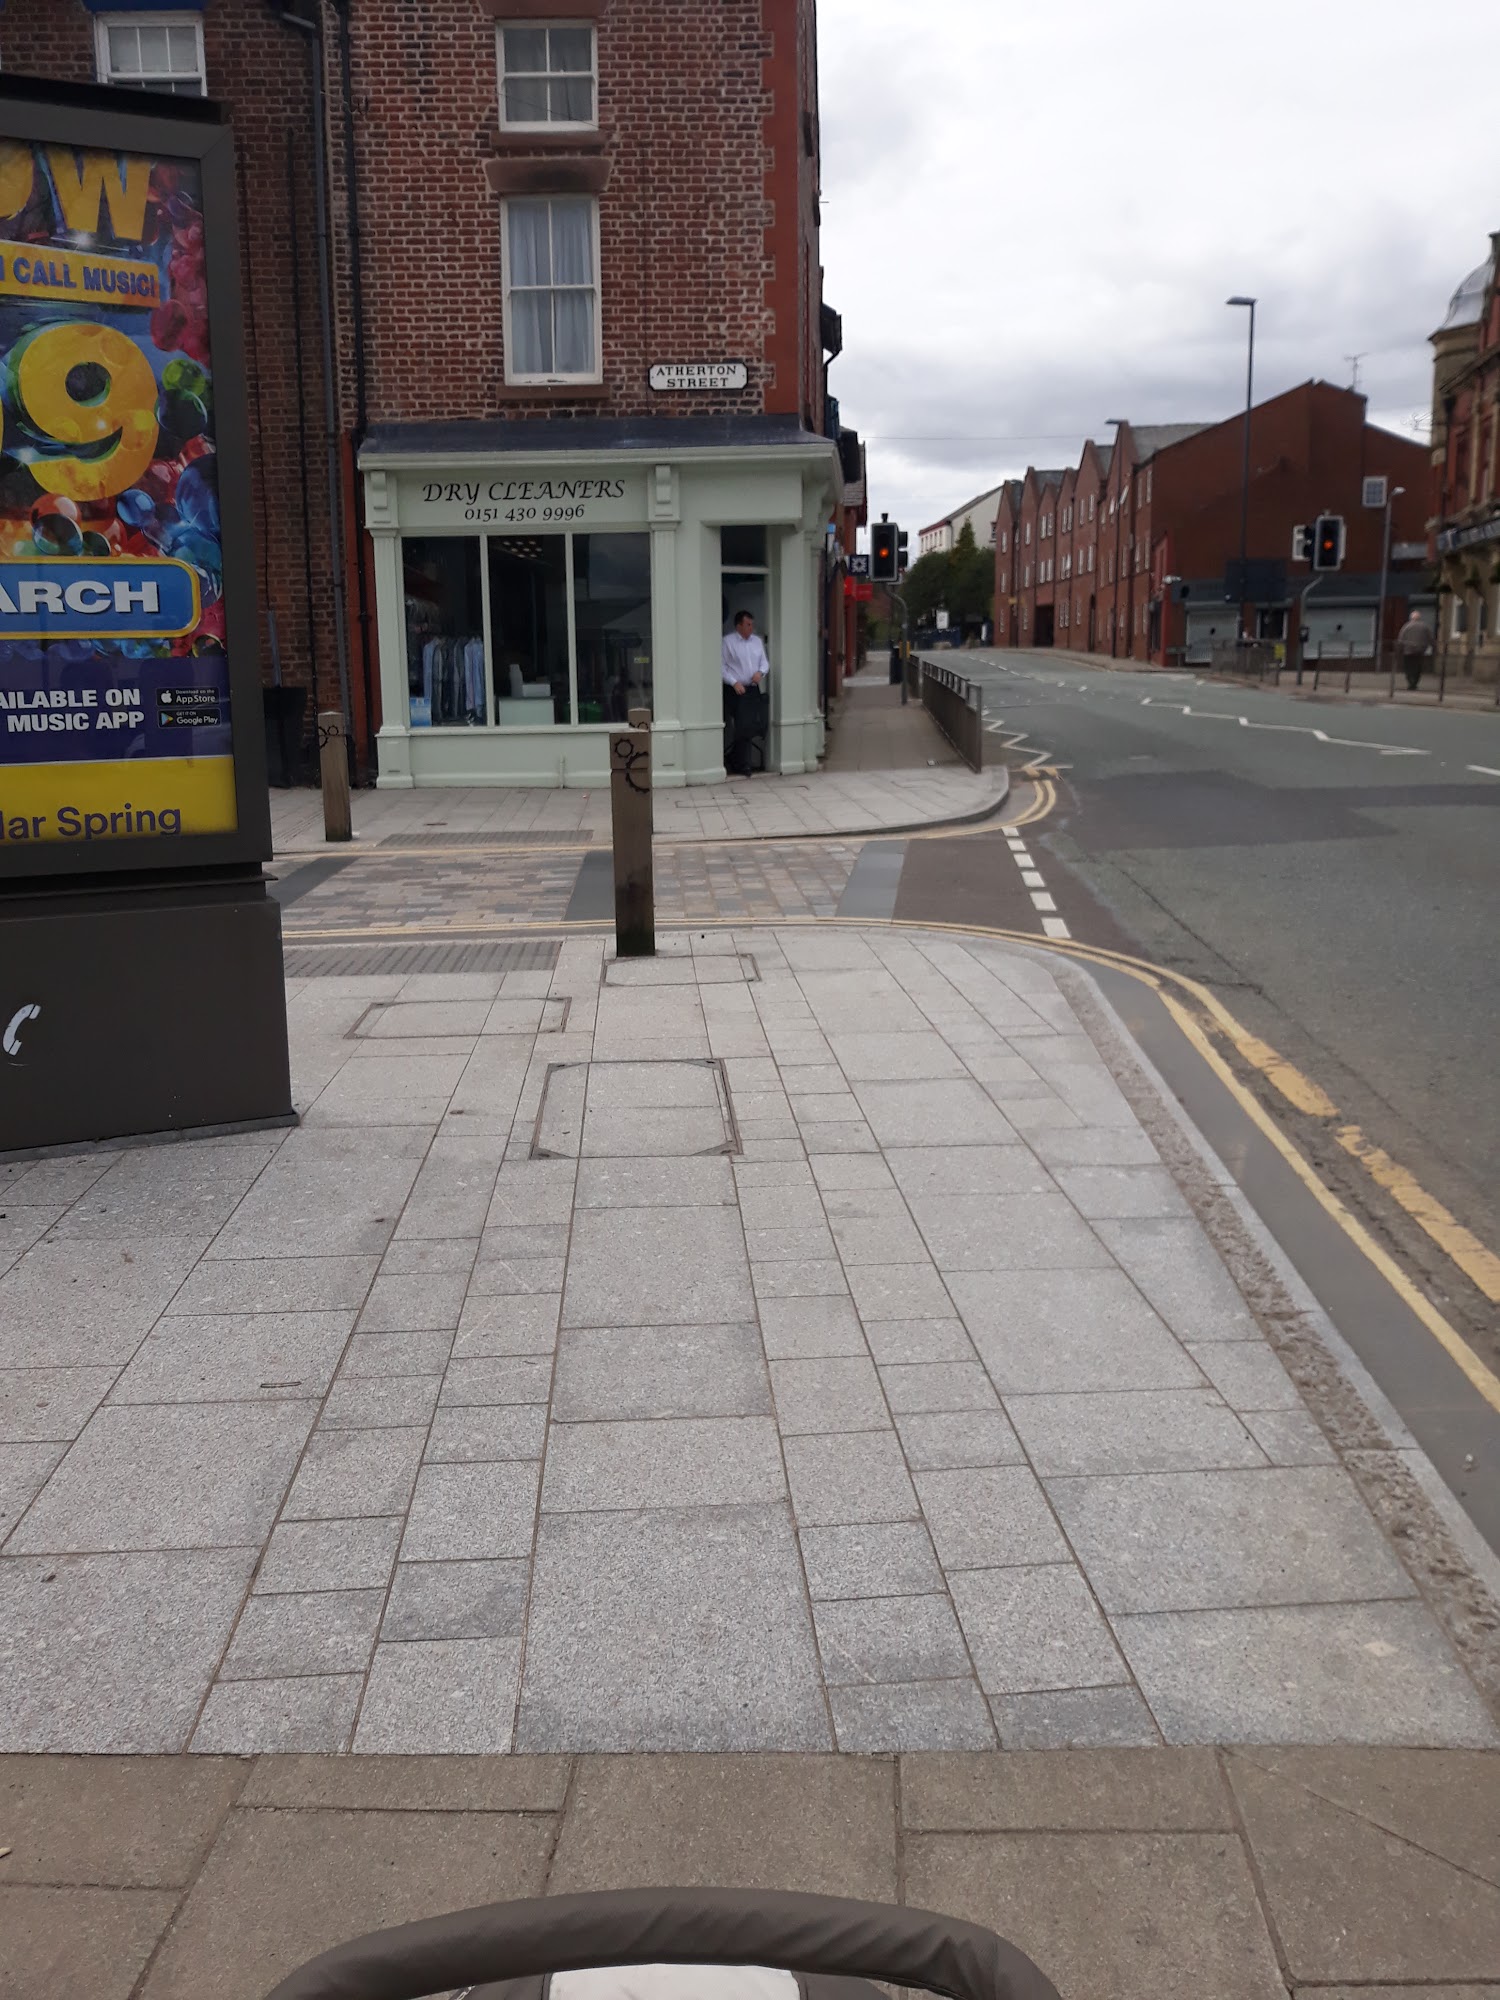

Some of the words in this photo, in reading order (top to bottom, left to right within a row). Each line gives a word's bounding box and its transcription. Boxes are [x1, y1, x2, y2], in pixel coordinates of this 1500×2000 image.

[13, 257, 77, 288] CALL
[83, 266, 155, 297] MUSIC!
[656, 365, 738, 376] ATHERTON
[667, 377, 729, 388] STREET
[422, 481, 480, 505] DRY
[488, 479, 626, 501] CLEANERS
[464, 507, 498, 522] 0151
[504, 507, 536, 521] 430
[542, 504, 585, 521] 9996
[105, 688, 140, 706] ON
[176, 695, 193, 704] App
[194, 694, 216, 703] Store
[7, 712, 90, 732] MUSIC
[96, 711, 145, 730] APP
[176, 716, 202, 726] Google
[203, 715, 219, 725] Play
[57, 802, 181, 840] Spring
